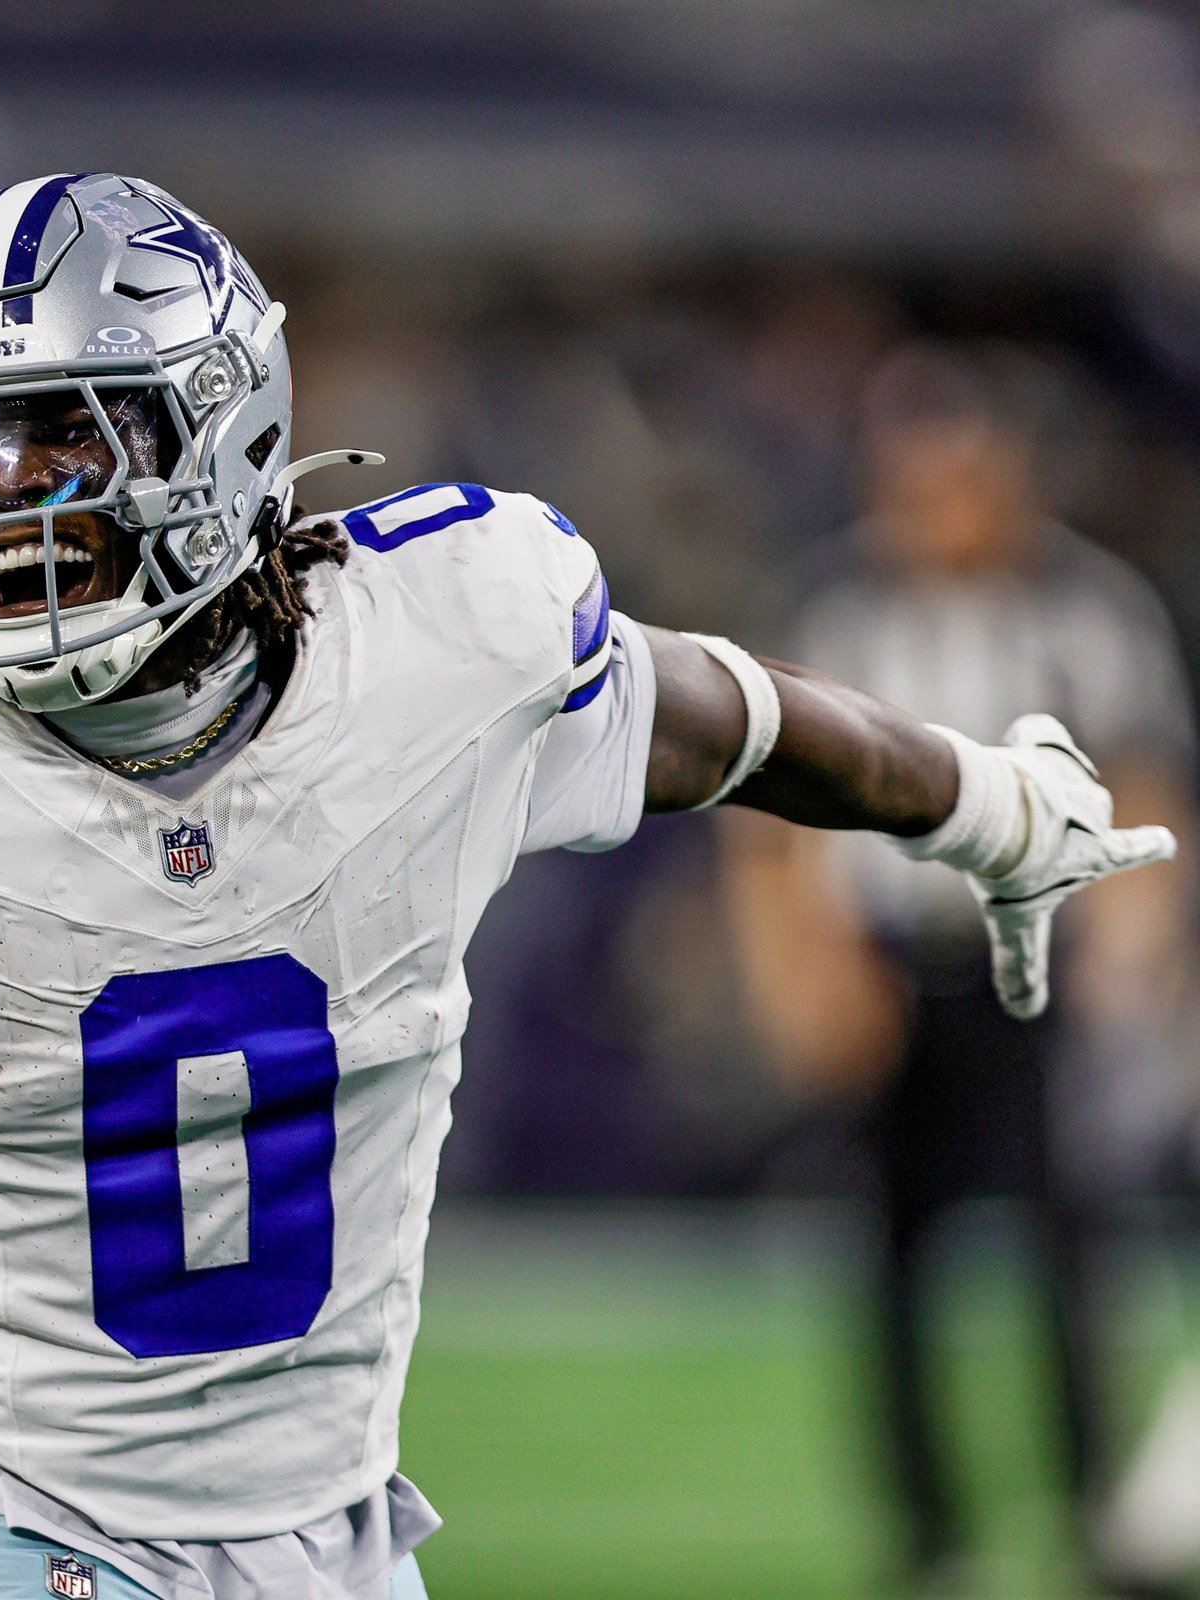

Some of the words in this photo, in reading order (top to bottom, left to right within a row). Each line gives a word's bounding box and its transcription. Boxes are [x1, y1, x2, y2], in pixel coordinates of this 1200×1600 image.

[86, 344, 151, 355] OAKLEY
[341, 483, 496, 553] 0
[169, 846, 208, 874] NFL
[79, 952, 340, 1359] 0
[56, 1572, 89, 1597] NFL
